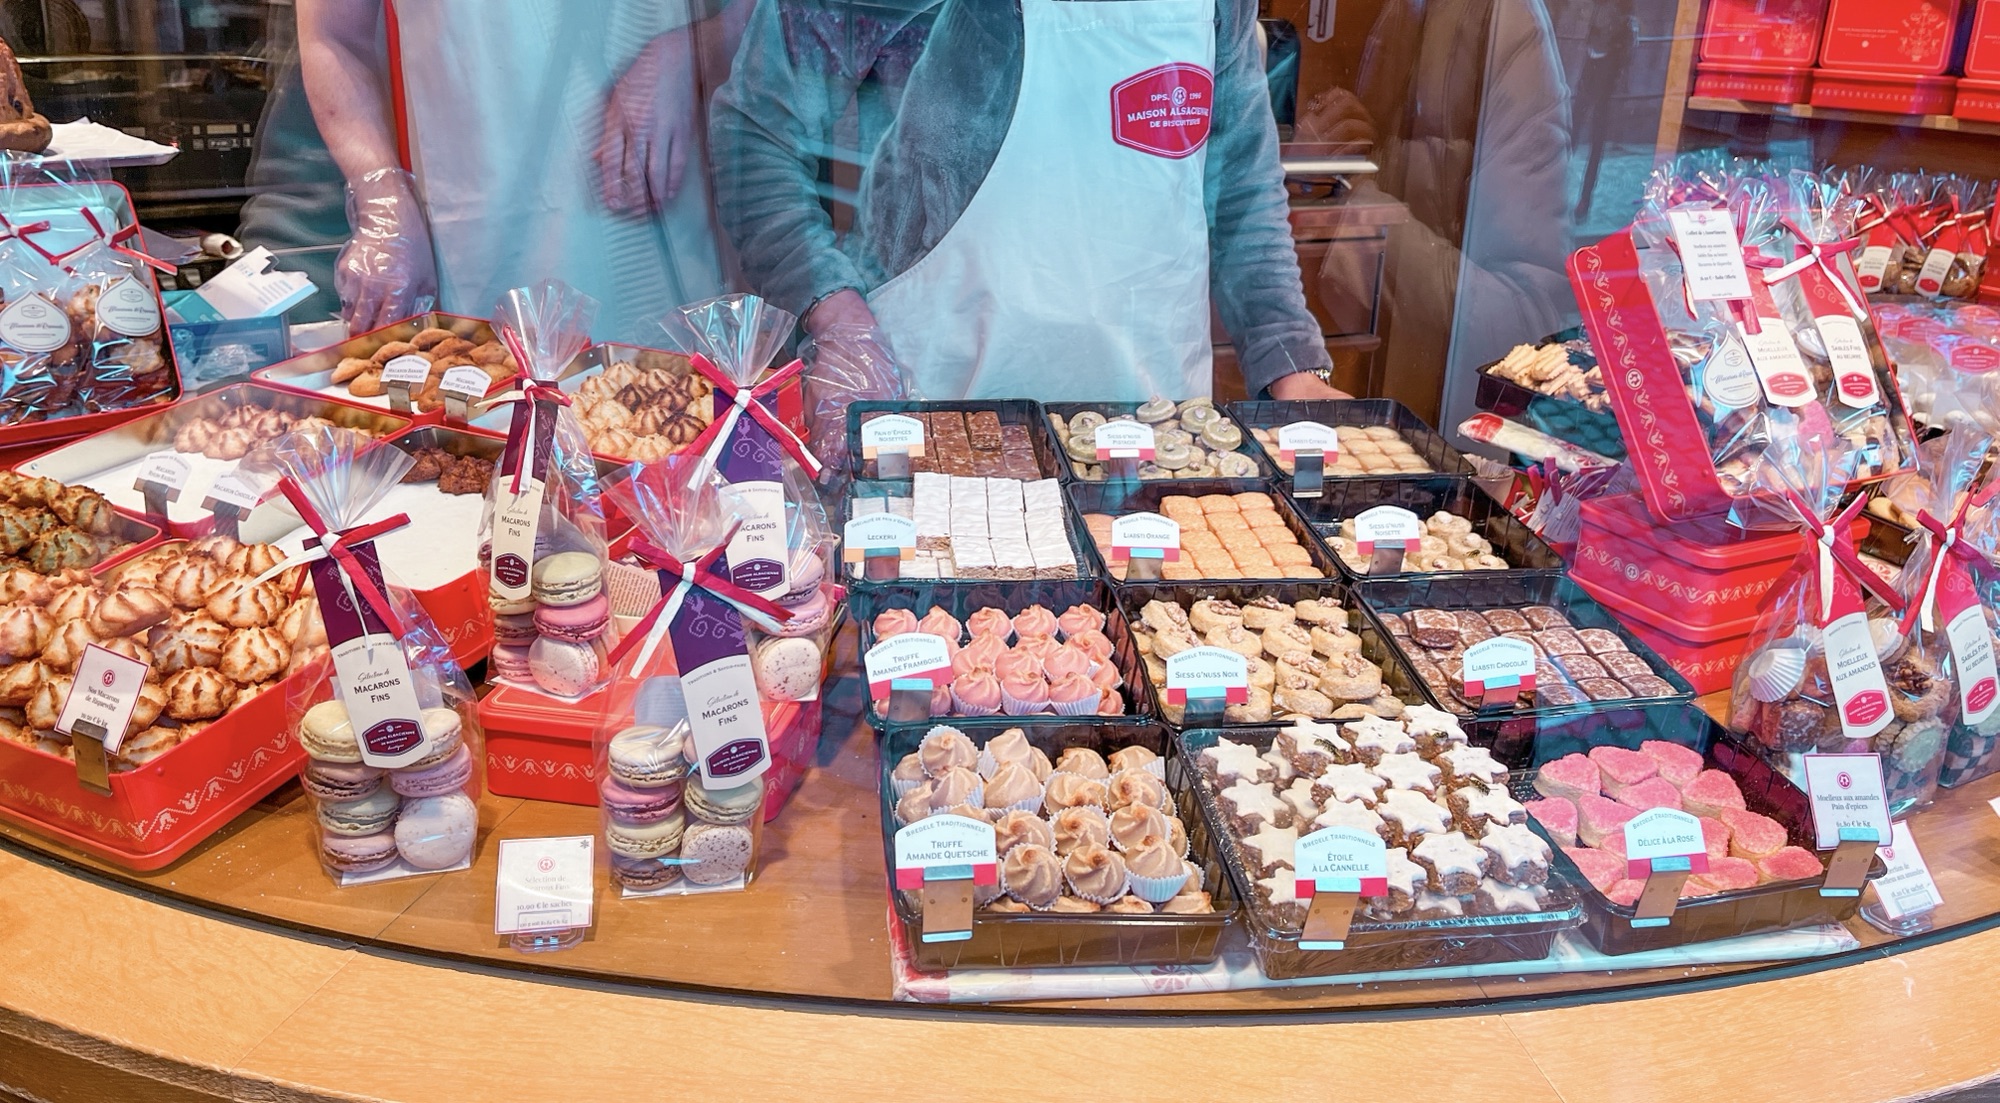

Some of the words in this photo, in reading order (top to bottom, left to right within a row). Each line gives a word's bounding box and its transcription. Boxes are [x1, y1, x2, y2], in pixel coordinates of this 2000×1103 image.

[1127, 108, 1167, 122] MAISON
[1150, 120, 1161, 128] DE
[501, 515, 531, 528] MACARONS
[740, 522, 777, 532] ACARONS
[508, 528, 521, 537] FINS
[746, 534, 765, 542] FINS
[1146, 532, 1170, 540] ORANGE
[892, 652, 920, 664] TRUFFE
[1837, 652, 1868, 670] MOELLEUX
[872, 664, 903, 678] AMANDE
[902, 656, 944, 670] FRAMBOISE
[1496, 660, 1528, 669] CHOCOLAT
[1222, 670, 1240, 678] NOIX
[1836, 672, 1848, 682] AUX
[1848, 661, 1876, 678] AMANDES
[354, 678, 401, 694] MACARONS
[88, 686, 98, 694] Nos
[98, 688, 120, 704] Macarons
[370, 693, 390, 704] FINS
[702, 698, 749, 720] MACARONS
[718, 714, 738, 726] FINS
[1816, 794, 1843, 802] Moelleux
[936, 820, 986, 833] TRADITIONNELS
[1330, 834, 1376, 848] TRADITIONNELS
[1676, 834, 1695, 843] ROSE
[930, 840, 963, 849] TRUFFE
[906, 852, 942, 861] AMANDE
[944, 850, 989, 859] QUETSCHE
[1330, 863, 1370, 872] CANNELLE
[558, 874, 566, 882] de
[536, 902, 542, 910] €
[550, 900, 573, 908] sachet
